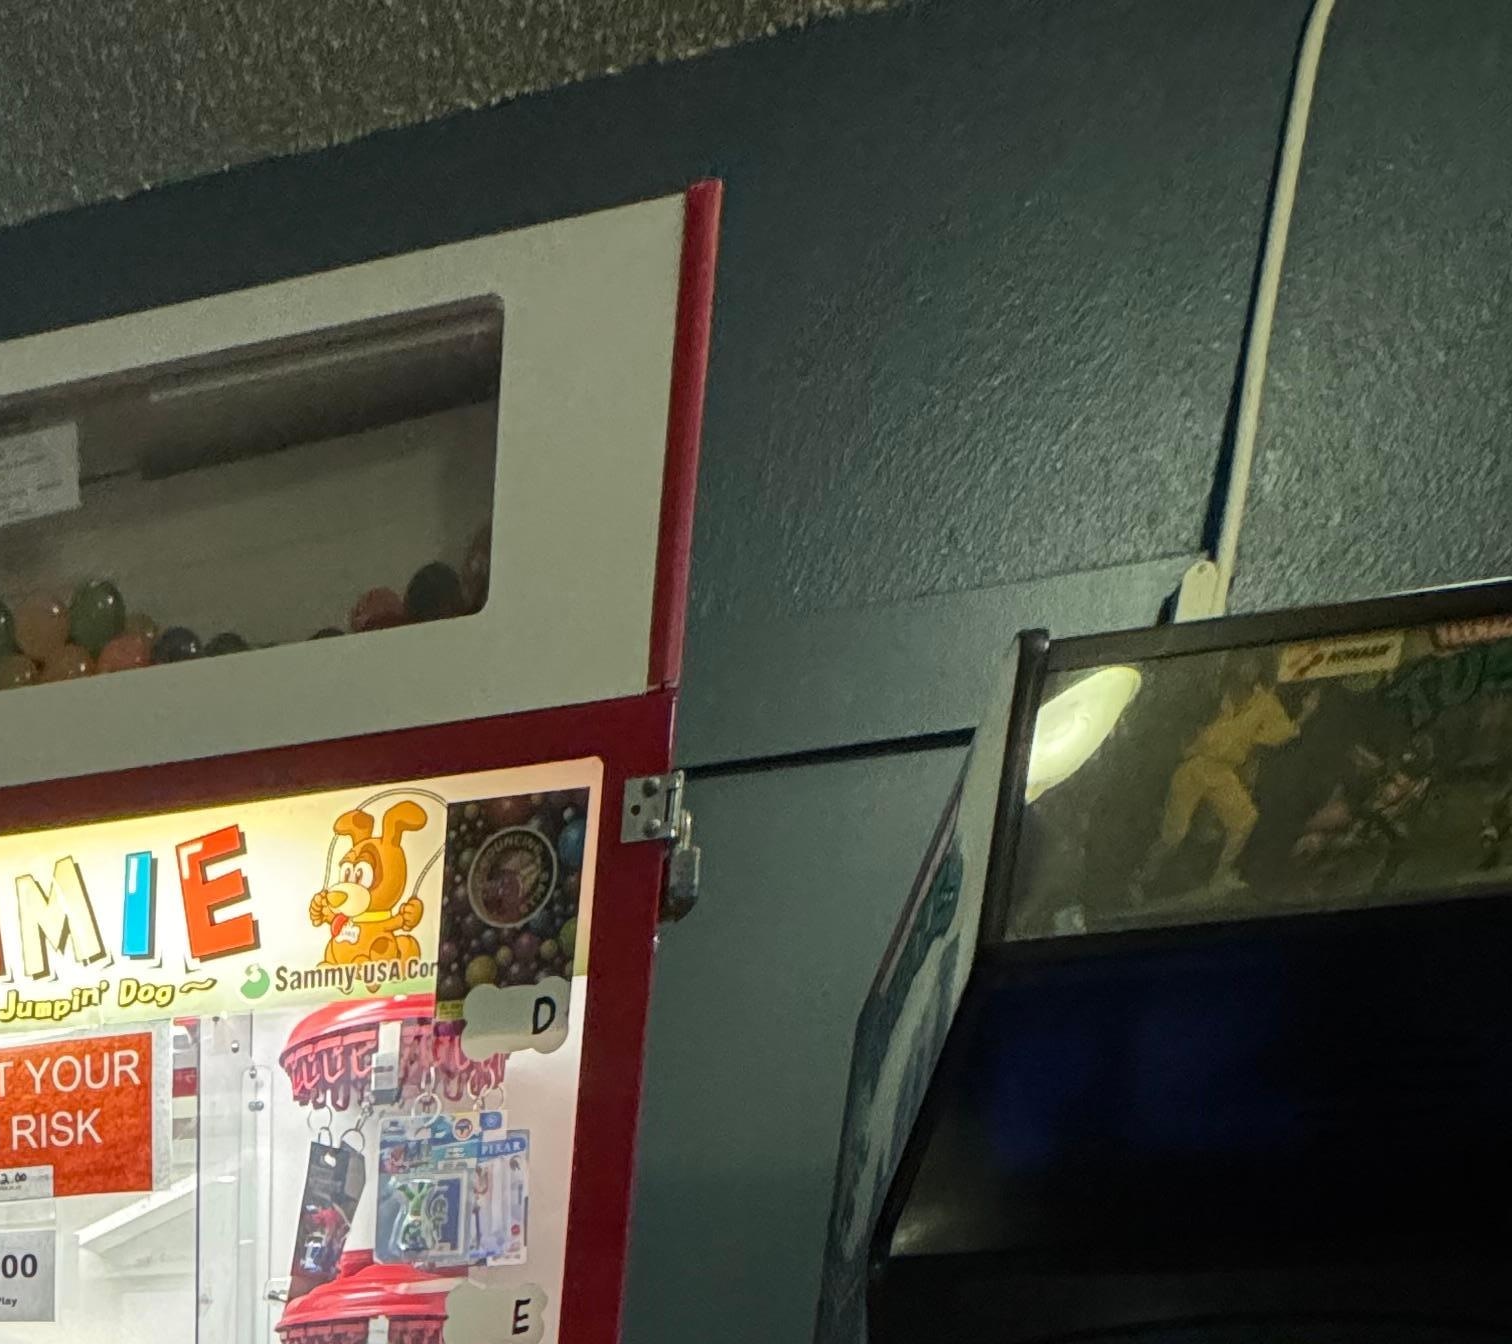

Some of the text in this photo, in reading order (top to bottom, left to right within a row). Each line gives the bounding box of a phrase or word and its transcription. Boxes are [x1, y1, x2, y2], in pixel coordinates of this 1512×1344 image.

[118, 978, 176, 1007] Dog
[275, 965, 355, 992] Sammy
[364, 960, 402, 983] USA
[532, 995, 556, 1035] D
[25, 1049, 141, 1096] YOUR
[12, 1107, 103, 1151] RISK
[512, 1298, 532, 1336] E
